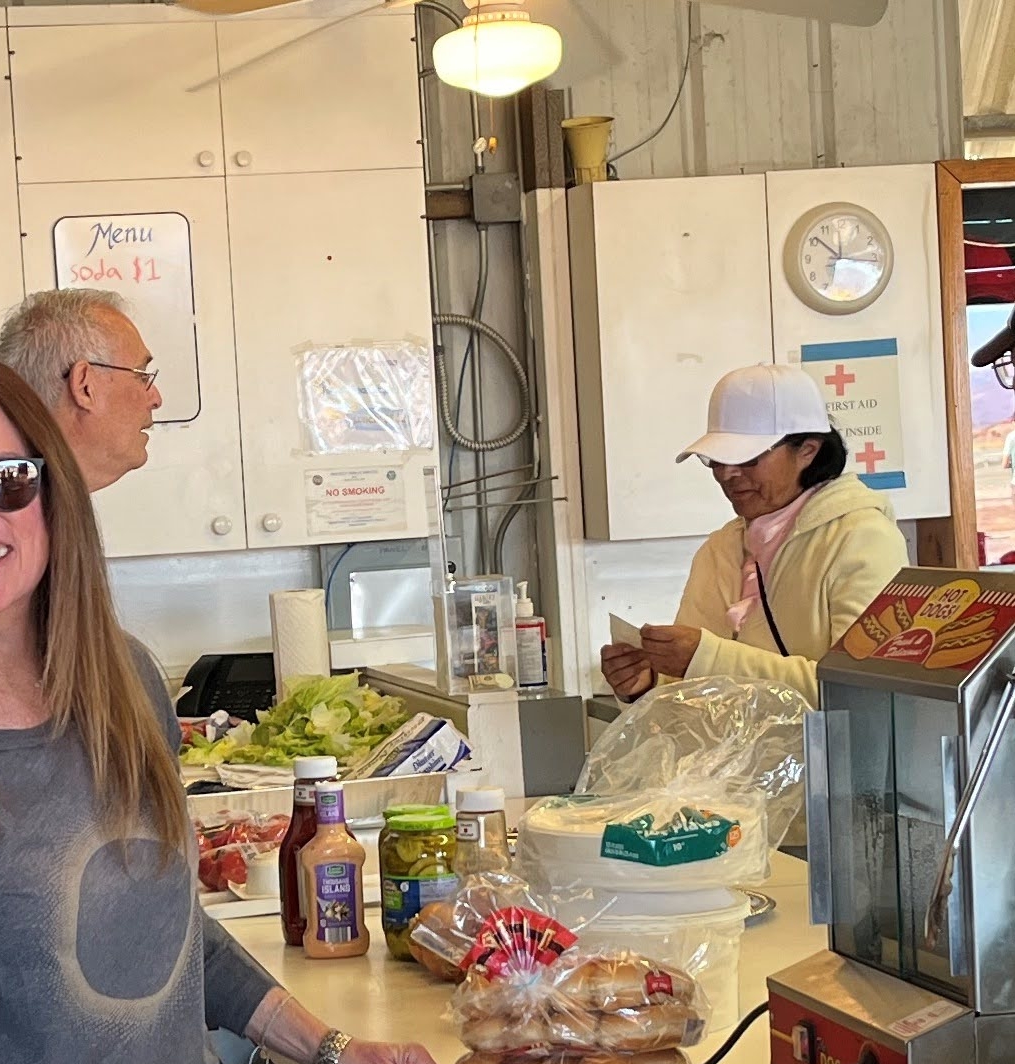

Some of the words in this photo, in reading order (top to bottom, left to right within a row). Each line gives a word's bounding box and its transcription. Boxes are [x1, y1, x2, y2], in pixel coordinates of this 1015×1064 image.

[820, 226, 830, 235] 11
[85, 222, 153, 257] Menu
[808, 237, 819, 247] 10
[866, 236, 874, 246] 2
[804, 254, 812, 264] 9
[871, 253, 878, 262] 3
[70, 258, 123, 283] soda
[132, 256, 161, 284] $1
[809, 271, 816, 282] 8
[825, 400, 856, 412] FIRST
[858, 399, 878, 409] AID
[845, 425, 882, 437] INSIDE
[325, 488, 340, 497] NO
[341, 486, 386, 497] SMOKING
[939, 588, 969, 602] HOT
[920, 603, 961, 619] DOGS!
[321, 883, 351, 894] ISLAND
